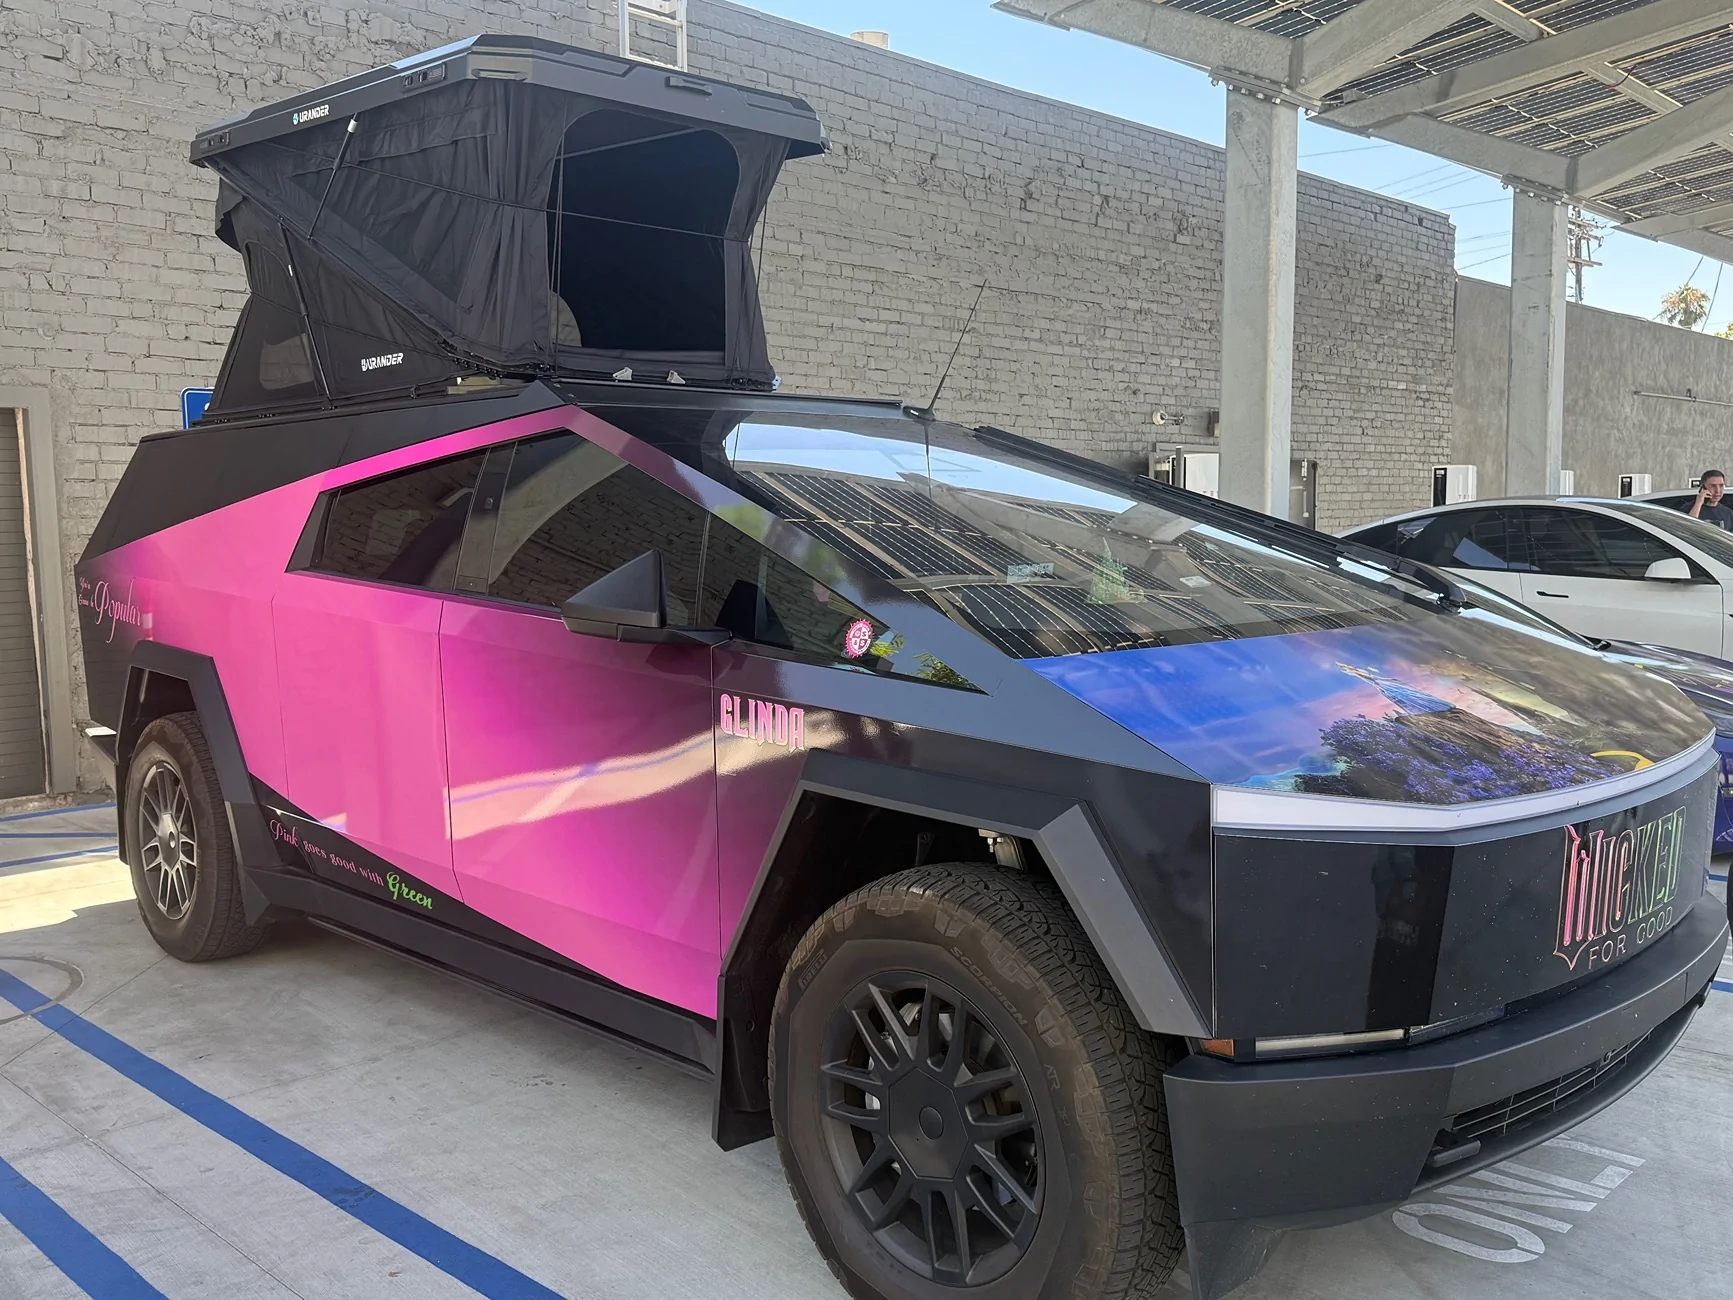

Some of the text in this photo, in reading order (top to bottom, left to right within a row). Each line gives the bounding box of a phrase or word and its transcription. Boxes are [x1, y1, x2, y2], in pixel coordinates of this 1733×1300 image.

[299, 104, 330, 123] URANDER
[366, 352, 404, 370] URANDER
[94, 578, 141, 644] Popular
[720, 693, 805, 753] GLINDA
[269, 819, 433, 910] Pink goes good with Green
[1553, 805, 1686, 971] WICKED
[1588, 905, 1673, 970] FOR GOOD
[950, 946, 1029, 1027] SCORPION
